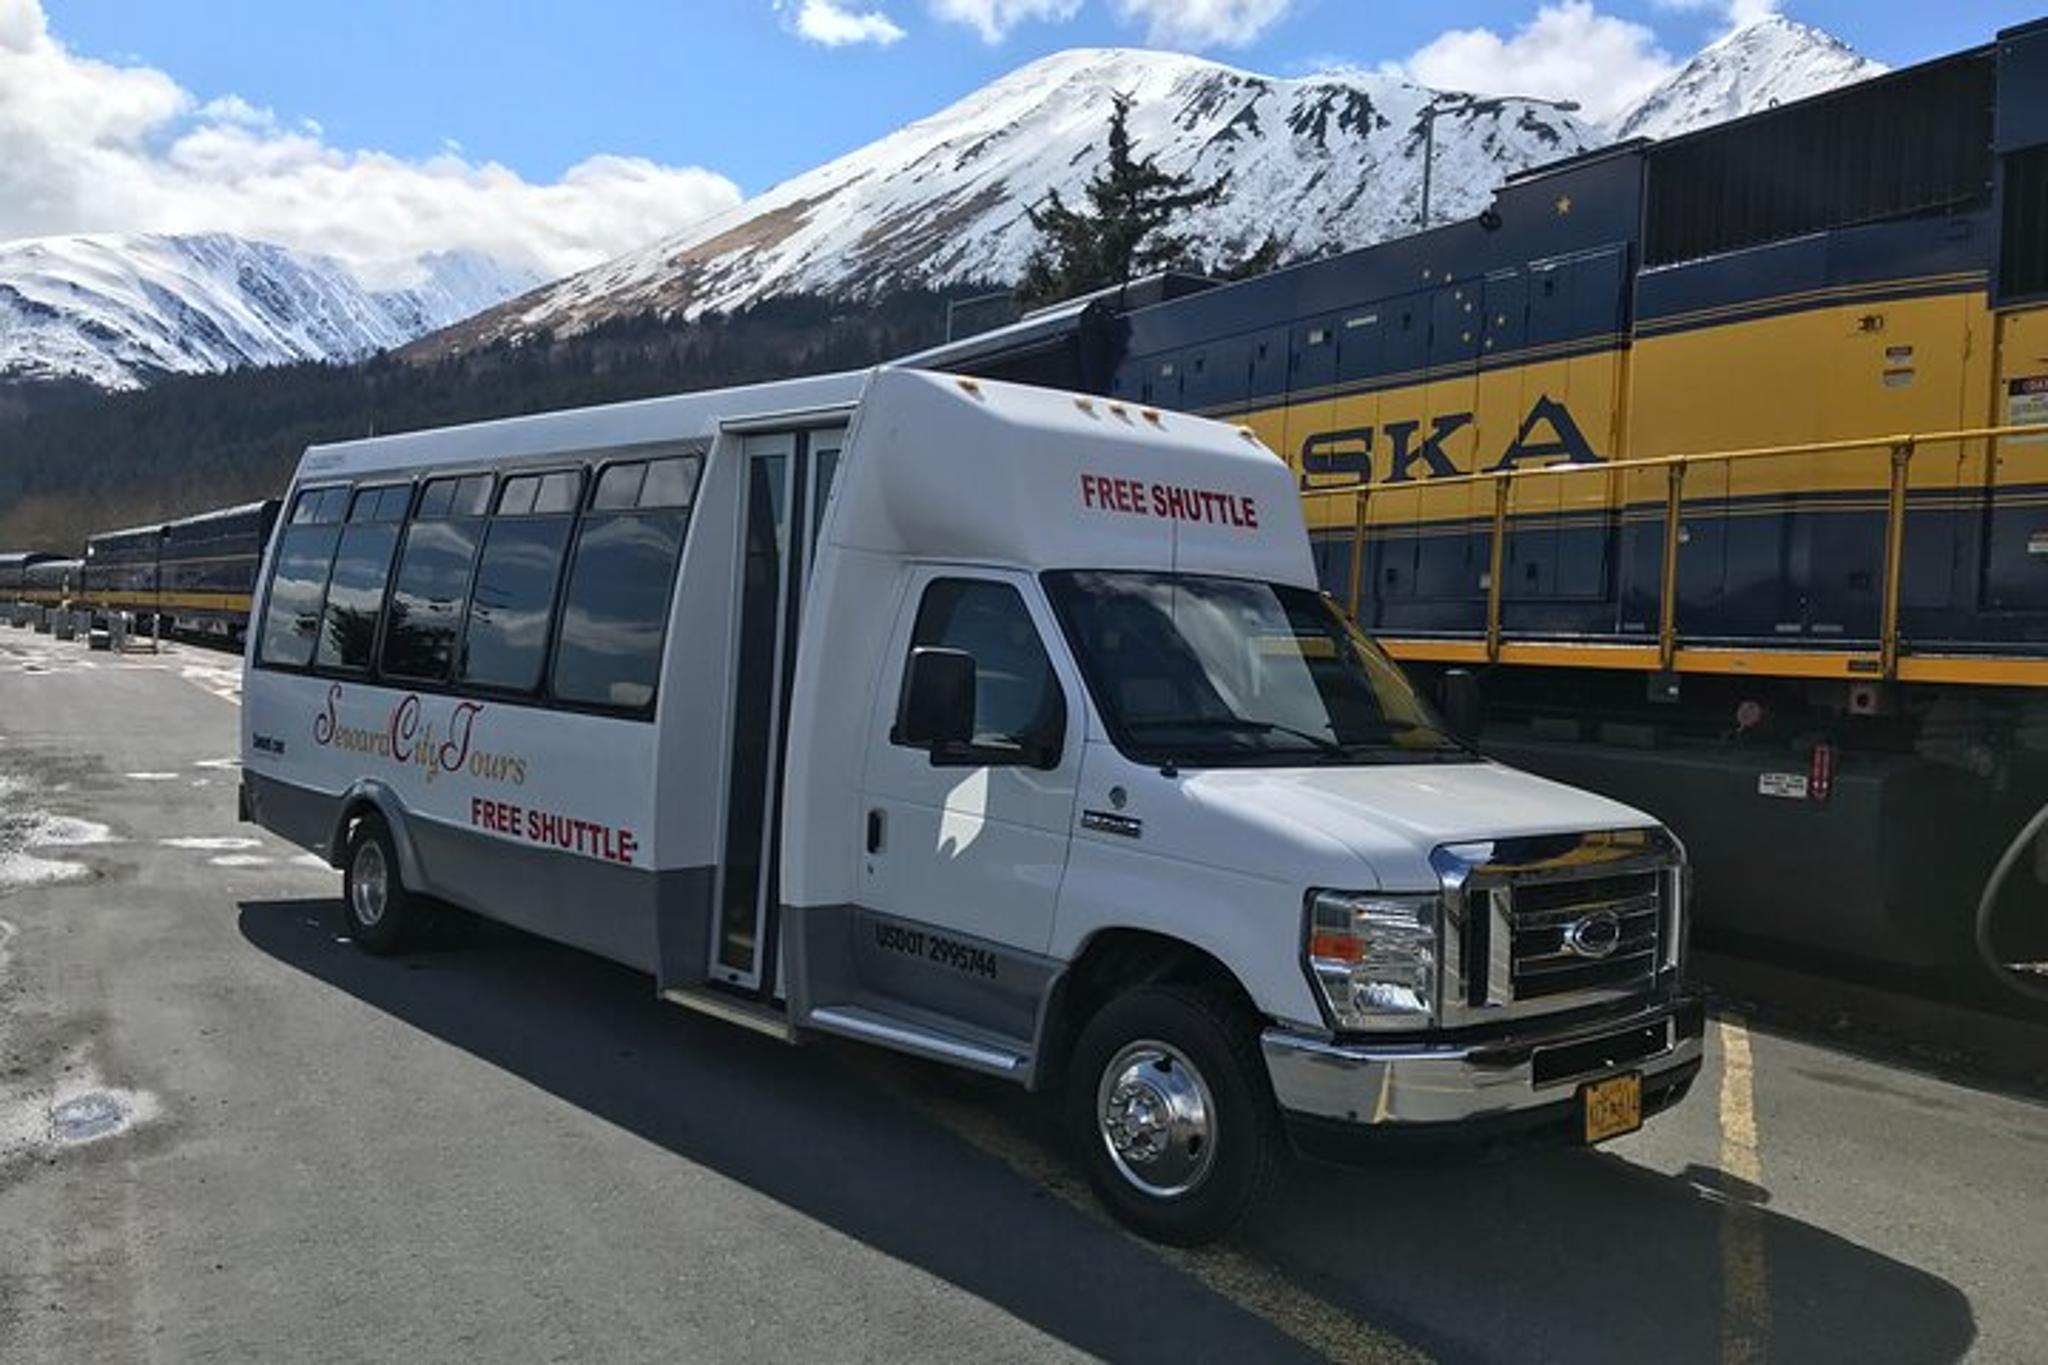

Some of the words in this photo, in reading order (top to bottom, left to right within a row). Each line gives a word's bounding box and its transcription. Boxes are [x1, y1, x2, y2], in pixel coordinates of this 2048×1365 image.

[1081, 474, 1147, 514] FREE
[1151, 484, 1258, 529] SHUTTLE
[471, 797, 522, 836] FREE
[528, 810, 633, 864] SHUTTLE
[875, 920, 925, 956] USDOT
